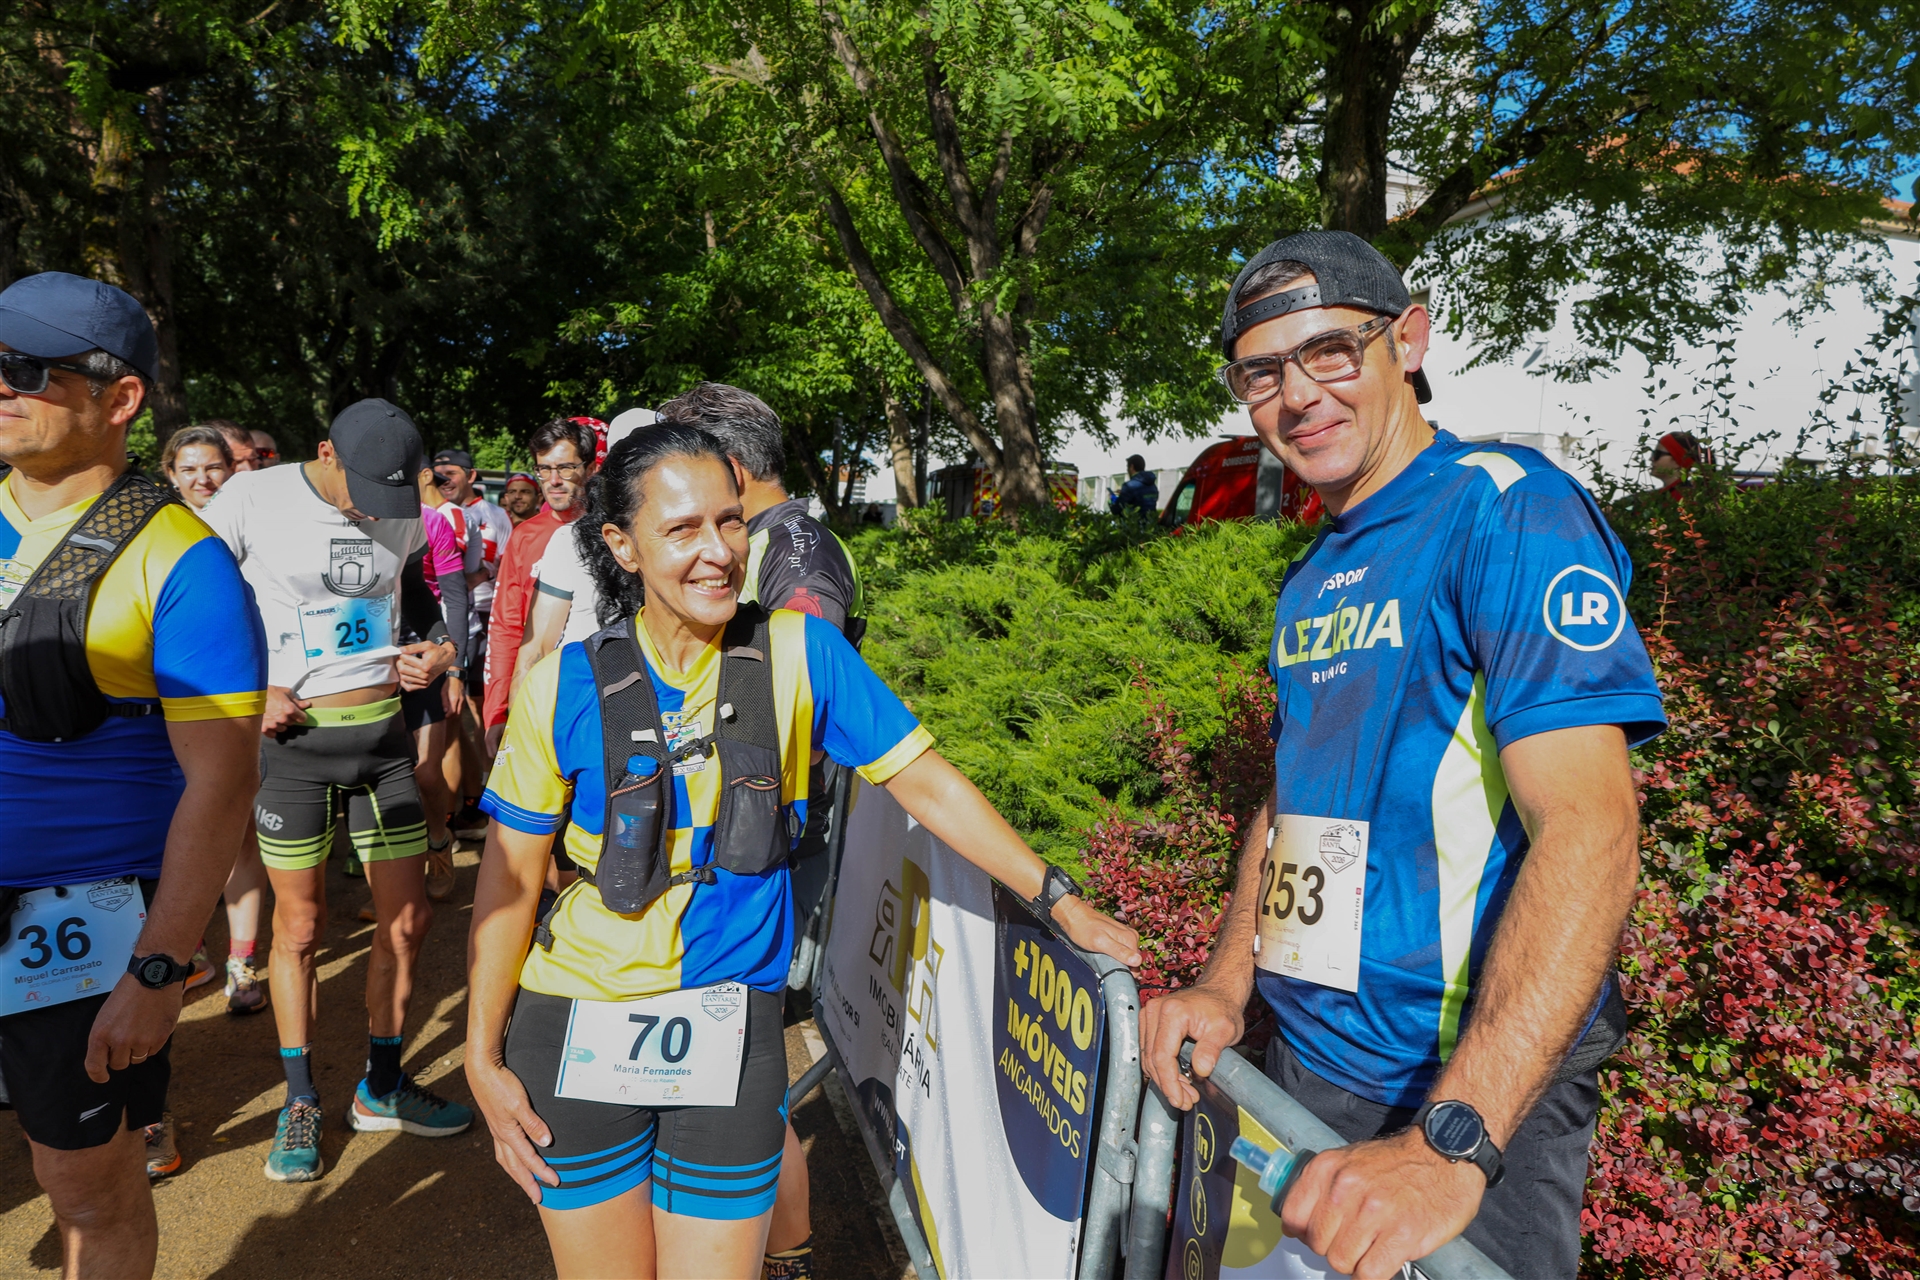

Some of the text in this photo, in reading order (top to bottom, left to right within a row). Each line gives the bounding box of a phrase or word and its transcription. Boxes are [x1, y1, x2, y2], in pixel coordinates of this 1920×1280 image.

[1222, 454, 1259, 467] BOMBEIROS
[335, 618, 370, 649] 25
[1277, 596, 1404, 669] LEZÍRIA
[1560, 591, 1610, 627] LR
[1262, 859, 1326, 926] 253
[17, 916, 92, 970] 36
[14, 960, 103, 985] Miguel Carrapato
[1013, 939, 1094, 1051] +1000
[628, 1013, 692, 1064] 70
[1006, 996, 1088, 1116] IMÓVEIS
[613, 1063, 693, 1077] Maria Fernandes
[998, 1046, 1082, 1159] ANGARIADOS
